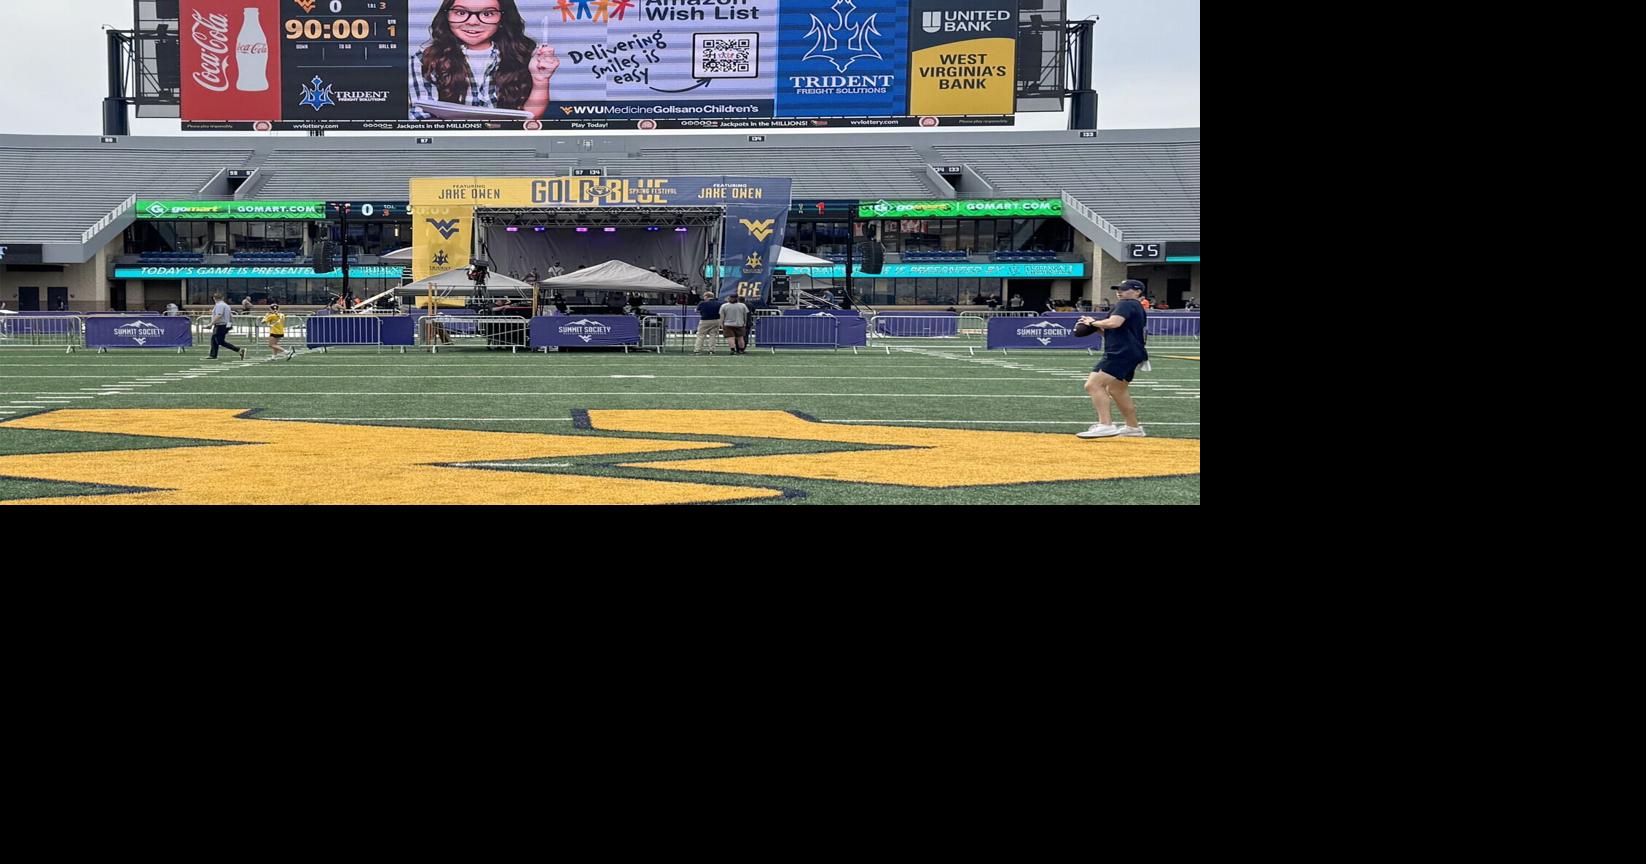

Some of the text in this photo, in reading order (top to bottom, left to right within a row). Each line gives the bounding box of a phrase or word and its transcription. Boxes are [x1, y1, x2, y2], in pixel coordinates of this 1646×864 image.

[379, 2, 386, 10] 3
[646, 6, 760, 21] Wish List
[944, 10, 1011, 21] UNITED
[285, 19, 370, 39] 90:00
[387, 25, 396, 37] 1
[944, 21, 992, 32] BANK
[568, 30, 667, 65] Delivering
[646, 49, 660, 64] is
[939, 54, 987, 65] WEST
[613, 67, 649, 84] easy
[919, 66, 1007, 78] VIRGINIA'S
[790, 75, 894, 88] TRIDENT
[939, 79, 986, 90] BANK
[438, 188, 500, 200] JAKE OWEN
[532, 179, 596, 203] GOLD
[606, 179, 668, 204] BLUE
[698, 187, 762, 199] JAKE OWEN
[237, 205, 315, 213] GOMART.COM
[361, 203, 374, 216] 0
[966, 202, 1050, 211] GOMART.COM
[1133, 245, 1158, 257] 25
[141, 267, 192, 275] TODAY'S
[196, 267, 235, 275] GAME
[238, 267, 247, 275] IS
[1016, 328, 1071, 336] SUMMIT SOCIETY
